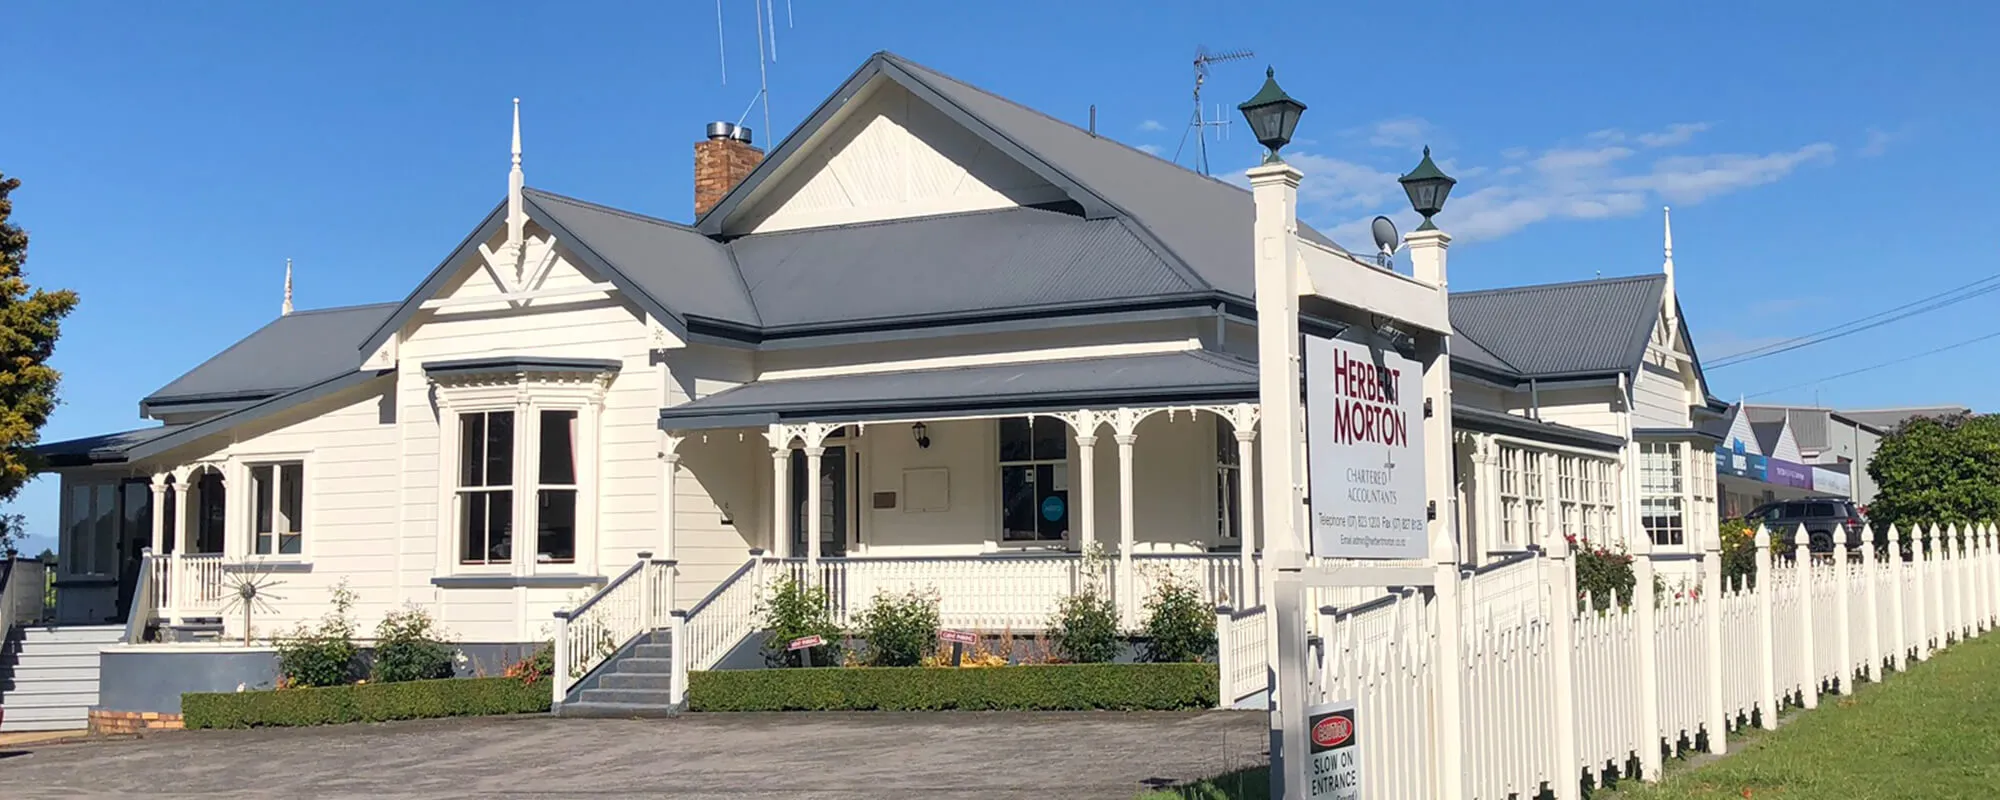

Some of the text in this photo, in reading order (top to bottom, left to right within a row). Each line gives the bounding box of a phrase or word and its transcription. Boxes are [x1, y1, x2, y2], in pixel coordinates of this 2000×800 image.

[1334, 347, 1400, 406] HERBERT
[1334, 397, 1407, 448] MORTON
[1346, 467, 1388, 486] CHARTERED
[1347, 487, 1398, 505] ACCOUNTANTS
[1318, 512, 1346, 529] Telephone
[1313, 751, 1353, 775] SLOW ON
[1312, 770, 1356, 797] ENTRANCE
